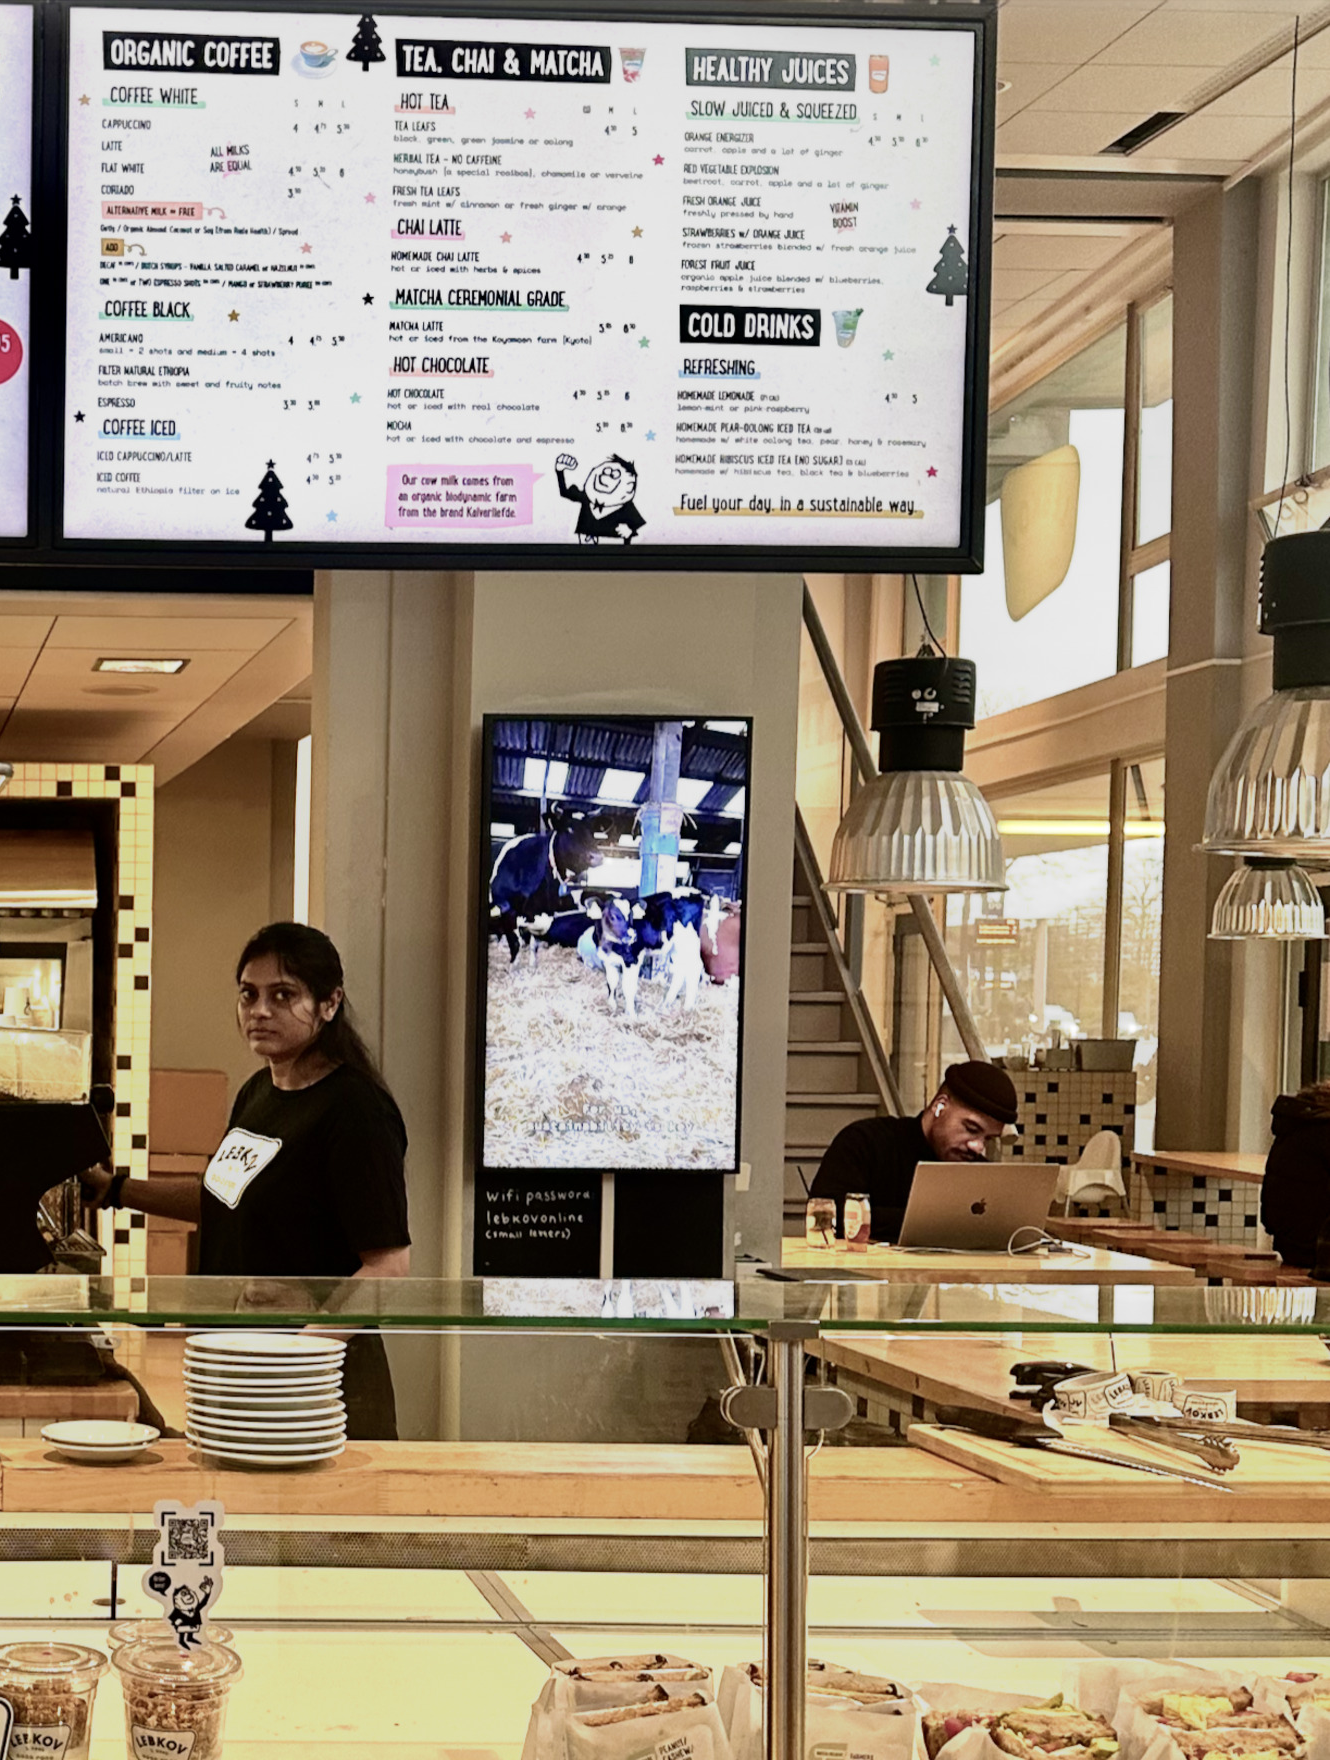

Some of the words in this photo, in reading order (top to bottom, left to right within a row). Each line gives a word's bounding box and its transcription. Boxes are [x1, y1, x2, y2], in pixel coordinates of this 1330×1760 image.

[111, 38, 194, 66] ORGANIC
[204, 41, 273, 68] COFFEE
[452, 48, 494, 74] CHAI
[504, 49, 520, 75] &
[530, 50, 604, 77] MATCHA
[693, 56, 772, 82] HEALTHY
[782, 59, 849, 85] JUICES
[110, 87, 154, 103] COFFEE
[160, 88, 198, 104] WHITE
[401, 94, 423, 110] HOT
[430, 94, 448, 110] TEA
[691, 100, 725, 116] SLOW
[733, 101, 773, 118] JUICED
[780, 103, 790, 118] &
[797, 104, 857, 120] SQUEEZED
[102, 119, 151, 130] CAPPUCCINO
[210, 147, 224, 158] ALL
[226, 145, 249, 156] MILKS
[210, 161, 224, 173] ARE
[227, 160, 252, 172] EQUAL
[829, 202, 859, 214] VITAMIN
[398, 219, 424, 236] CHAI
[429, 219, 462, 236] LATTE
[833, 217, 857, 228] BOOST
[395, 289, 442, 306] MATCHA
[448, 290, 522, 307] CEREMONIAL
[527, 291, 566, 307] GRADE
[105, 300, 150, 317] COFFEE
[153, 302, 190, 318] BLACK
[688, 312, 735, 338] COLD
[745, 313, 814, 340] DRINKS
[99, 333, 143, 344] AMERICANO
[394, 356, 416, 373] HOT
[422, 357, 489, 373] CHOCOLATE
[683, 359, 756, 376] REFRESHING
[98, 398, 135, 408] ESPRESSO
[103, 419, 146, 436] COFFEE
[151, 420, 176, 436] ICED
[387, 421, 411, 431] MOCHA
[676, 423, 717, 433] HOMEMADE
[777, 423, 793, 433] ICED
[797, 424, 811, 434] TEA
[402, 475, 417, 486] Our
[421, 476, 438, 487] cow
[441, 475, 459, 486] milk
[462, 476, 490, 487] comes
[493, 475, 514, 487] from
[399, 493, 408, 502] an
[412, 491, 442, 505] organic
[446, 491, 492, 505] biodynamic
[495, 491, 517, 502] farm
[681, 494, 707, 510] Fuel
[712, 498, 743, 514] your
[780, 496, 792, 511] in
[797, 499, 804, 512] a
[810, 495, 883, 512] sustainable
[889, 500, 918, 516] way.
[399, 507, 419, 518] from
[423, 507, 436, 518] the
[440, 507, 464, 518] brand
[526, 1190, 590, 1205] password
[136, 1735, 188, 1754] LEBKOV
